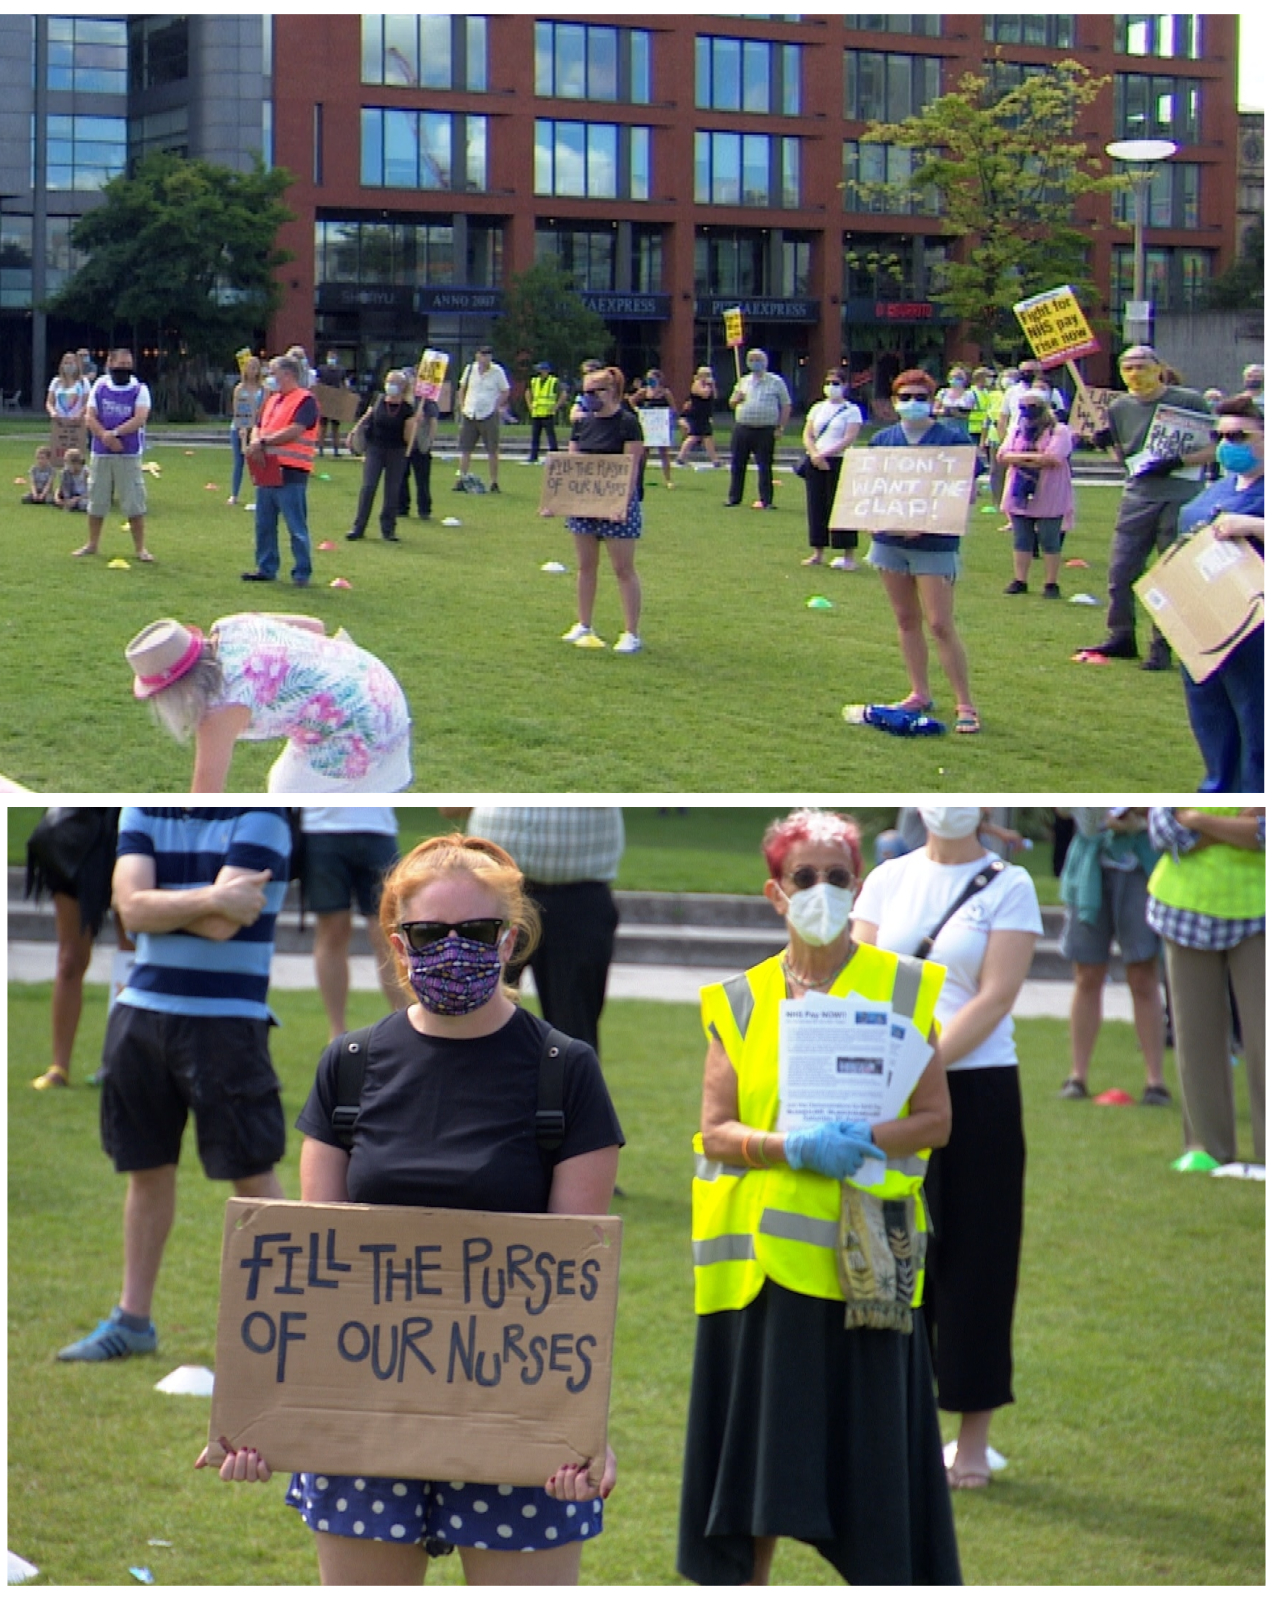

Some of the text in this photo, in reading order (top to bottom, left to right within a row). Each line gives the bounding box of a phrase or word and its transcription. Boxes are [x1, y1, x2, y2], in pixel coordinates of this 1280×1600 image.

[1020, 304, 1052, 325] Fight
[1052, 298, 1071, 312] for
[1027, 314, 1079, 339] NHS pay
[1035, 338, 1060, 354] rise
[1061, 327, 1087, 343] now
[852, 478, 968, 497] WANT THE
[854, 498, 938, 520] CLAP!
[240, 1229, 601, 1315] FILL THE PURSES
[241, 1311, 596, 1394] OF OUR NURSES
